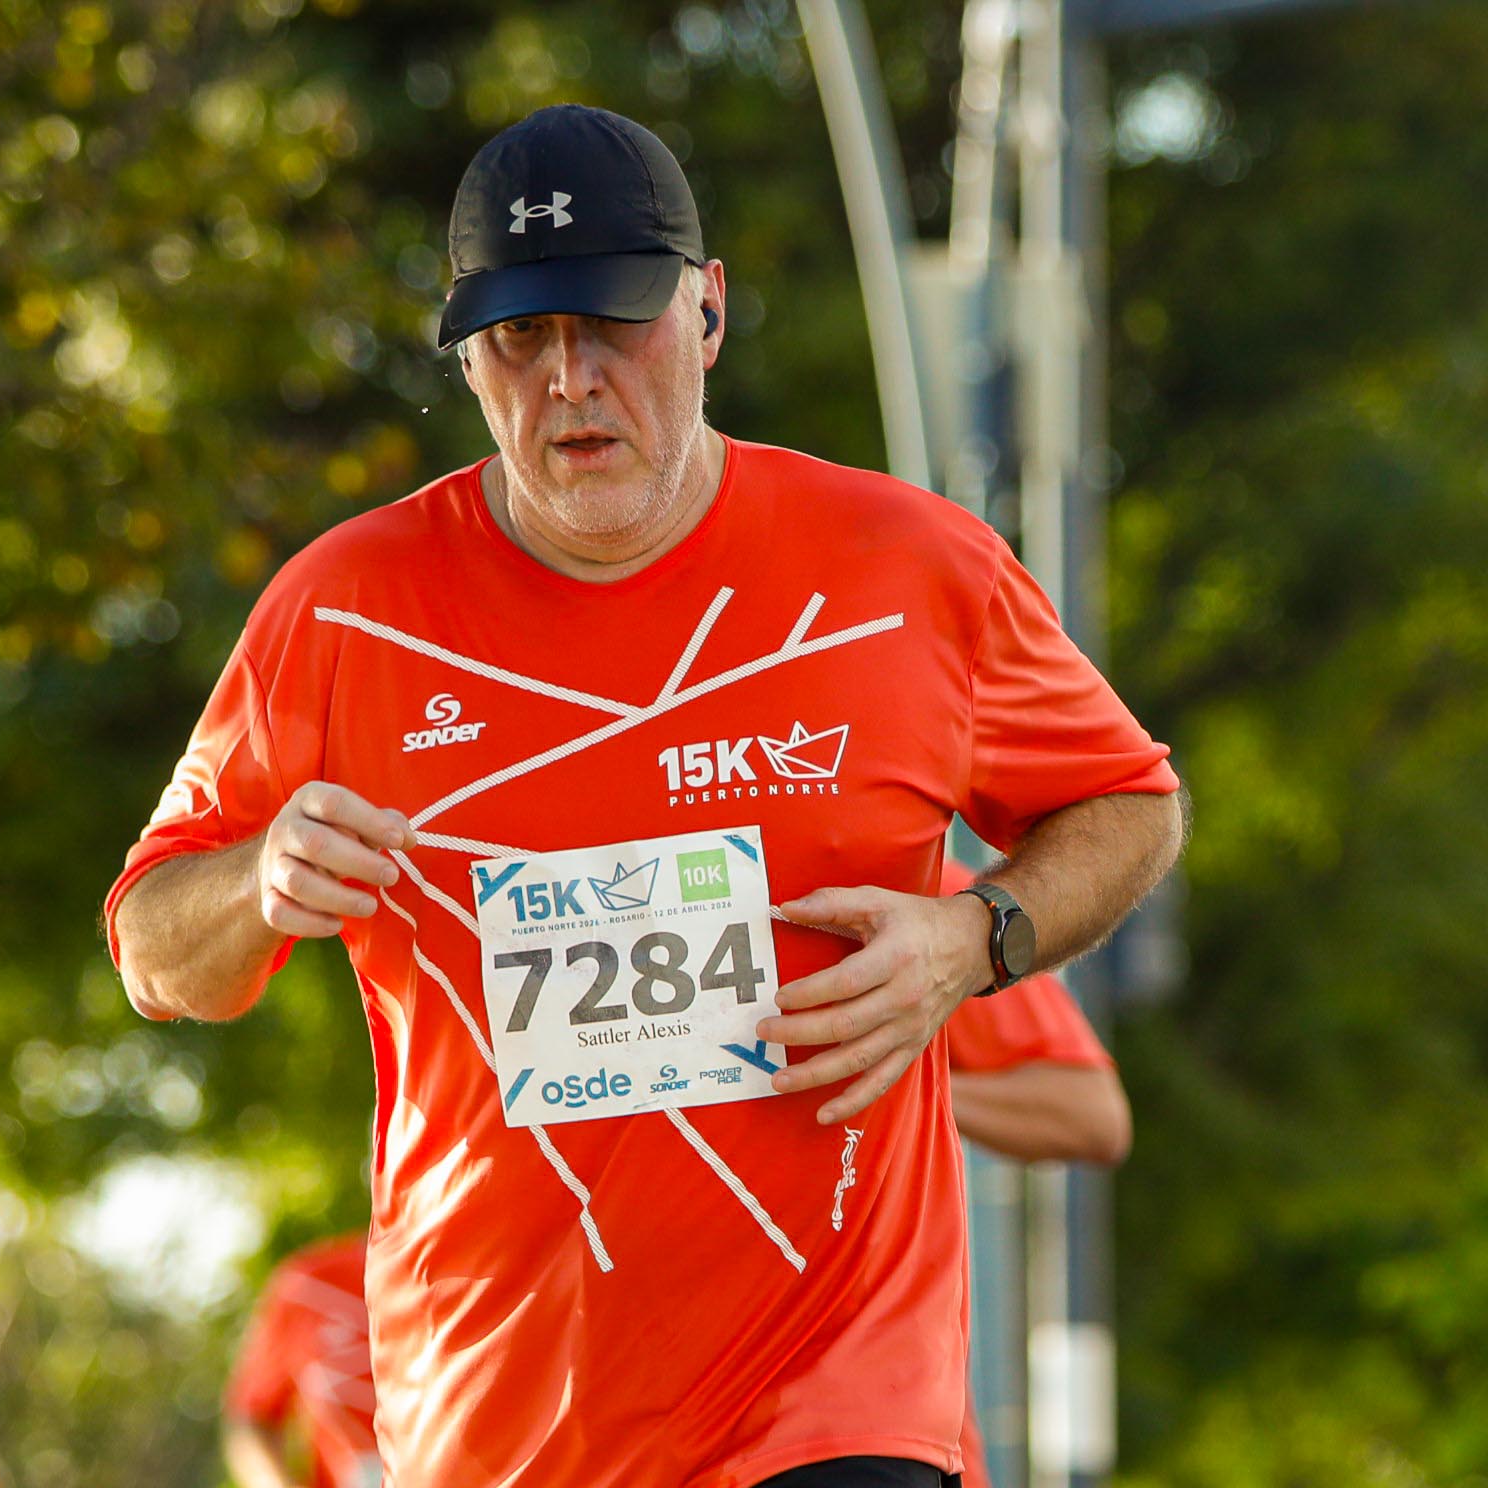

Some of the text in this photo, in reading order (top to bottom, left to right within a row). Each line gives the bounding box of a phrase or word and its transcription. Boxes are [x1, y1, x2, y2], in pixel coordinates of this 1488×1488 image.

[658, 737, 757, 791] 15K
[669, 783, 839, 807] PUERTO NORTE
[683, 864, 723, 887] 10K
[507, 879, 585, 922] 15K
[511, 924, 546, 936] PUERTO
[548, 921, 576, 932] NORTE
[579, 919, 600, 928] 2026
[609, 913, 646, 925] ROSARIO
[654, 910, 665, 918] 12
[667, 907, 679, 916] DE
[681, 903, 709, 914] ABRIL
[711, 901, 733, 911] 2026
[494, 922, 765, 1033] 7284
[577, 1021, 691, 1048] Sattler Alexis
[541, 1067, 633, 1105] osde
[699, 1066, 742, 1080] POWER
